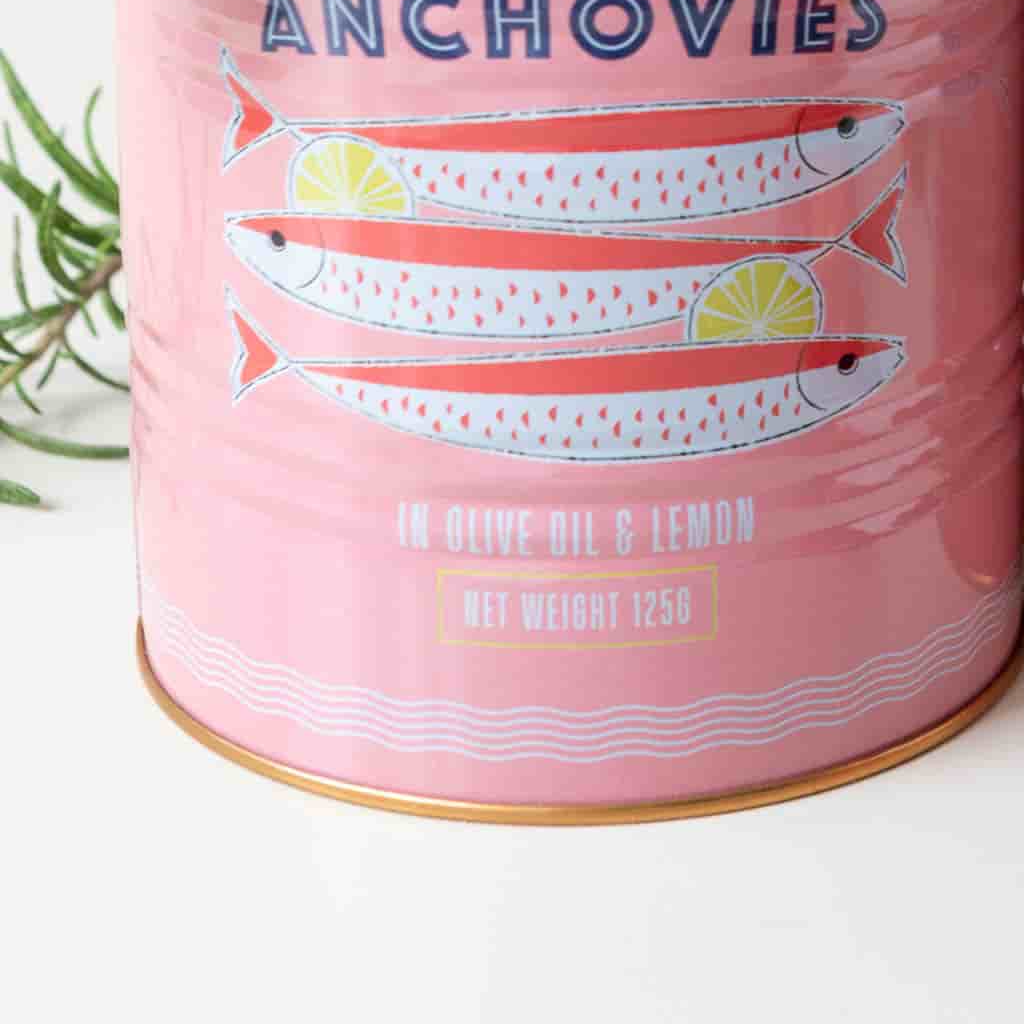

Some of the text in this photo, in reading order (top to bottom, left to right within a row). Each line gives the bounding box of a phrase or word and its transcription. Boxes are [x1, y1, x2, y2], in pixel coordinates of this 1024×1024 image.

[396, 495, 755, 557] IN OLIVE OIL & LEMON
[462, 585, 693, 632] NET WEIGHT 125G
